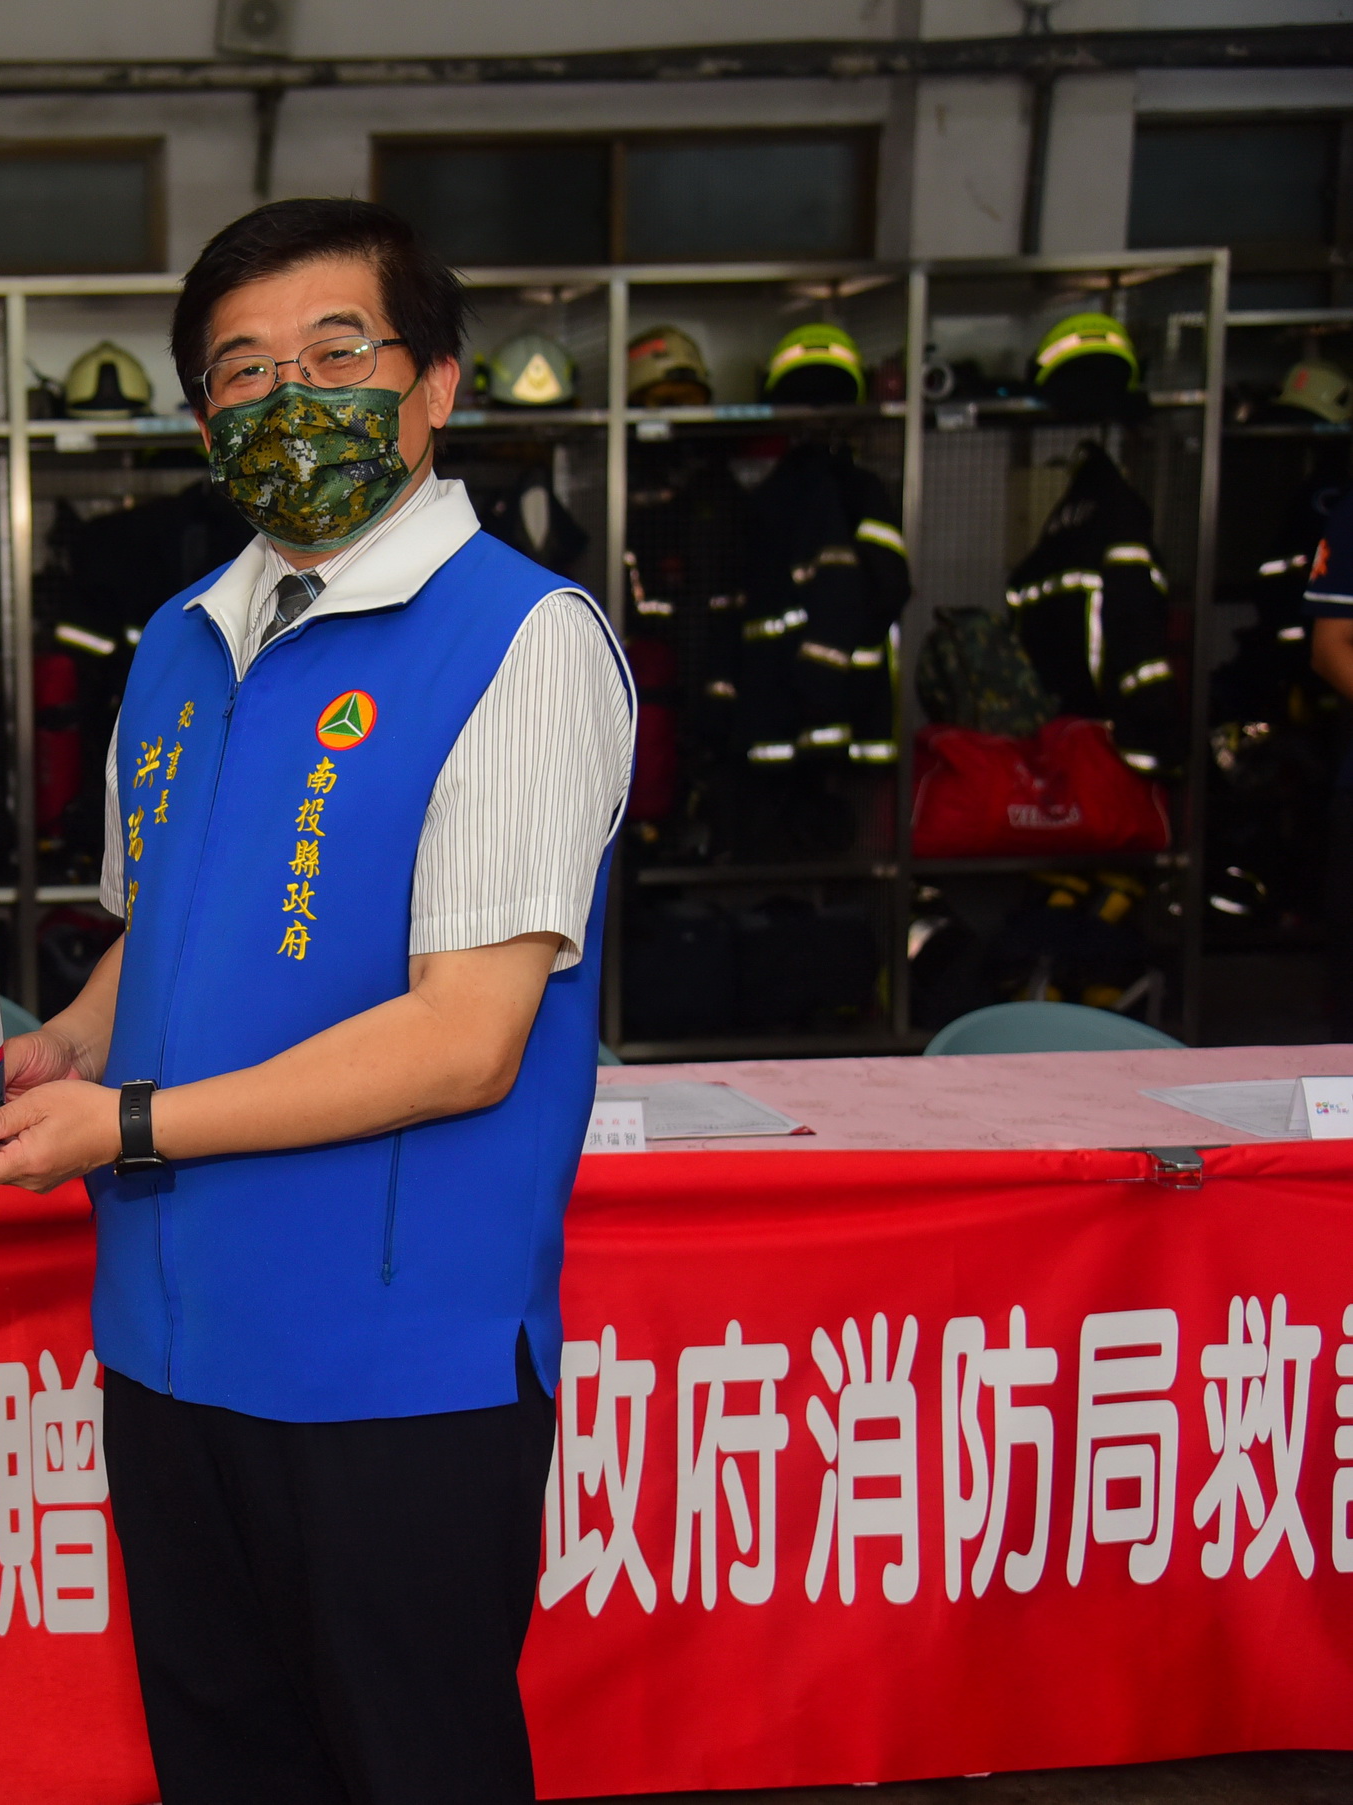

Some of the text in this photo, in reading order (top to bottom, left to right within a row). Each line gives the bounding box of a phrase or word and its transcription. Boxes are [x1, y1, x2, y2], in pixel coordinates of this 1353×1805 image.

[276, 756, 338, 961] 南投縣政府
[589, 1132, 637, 1146] 洪瑞智
